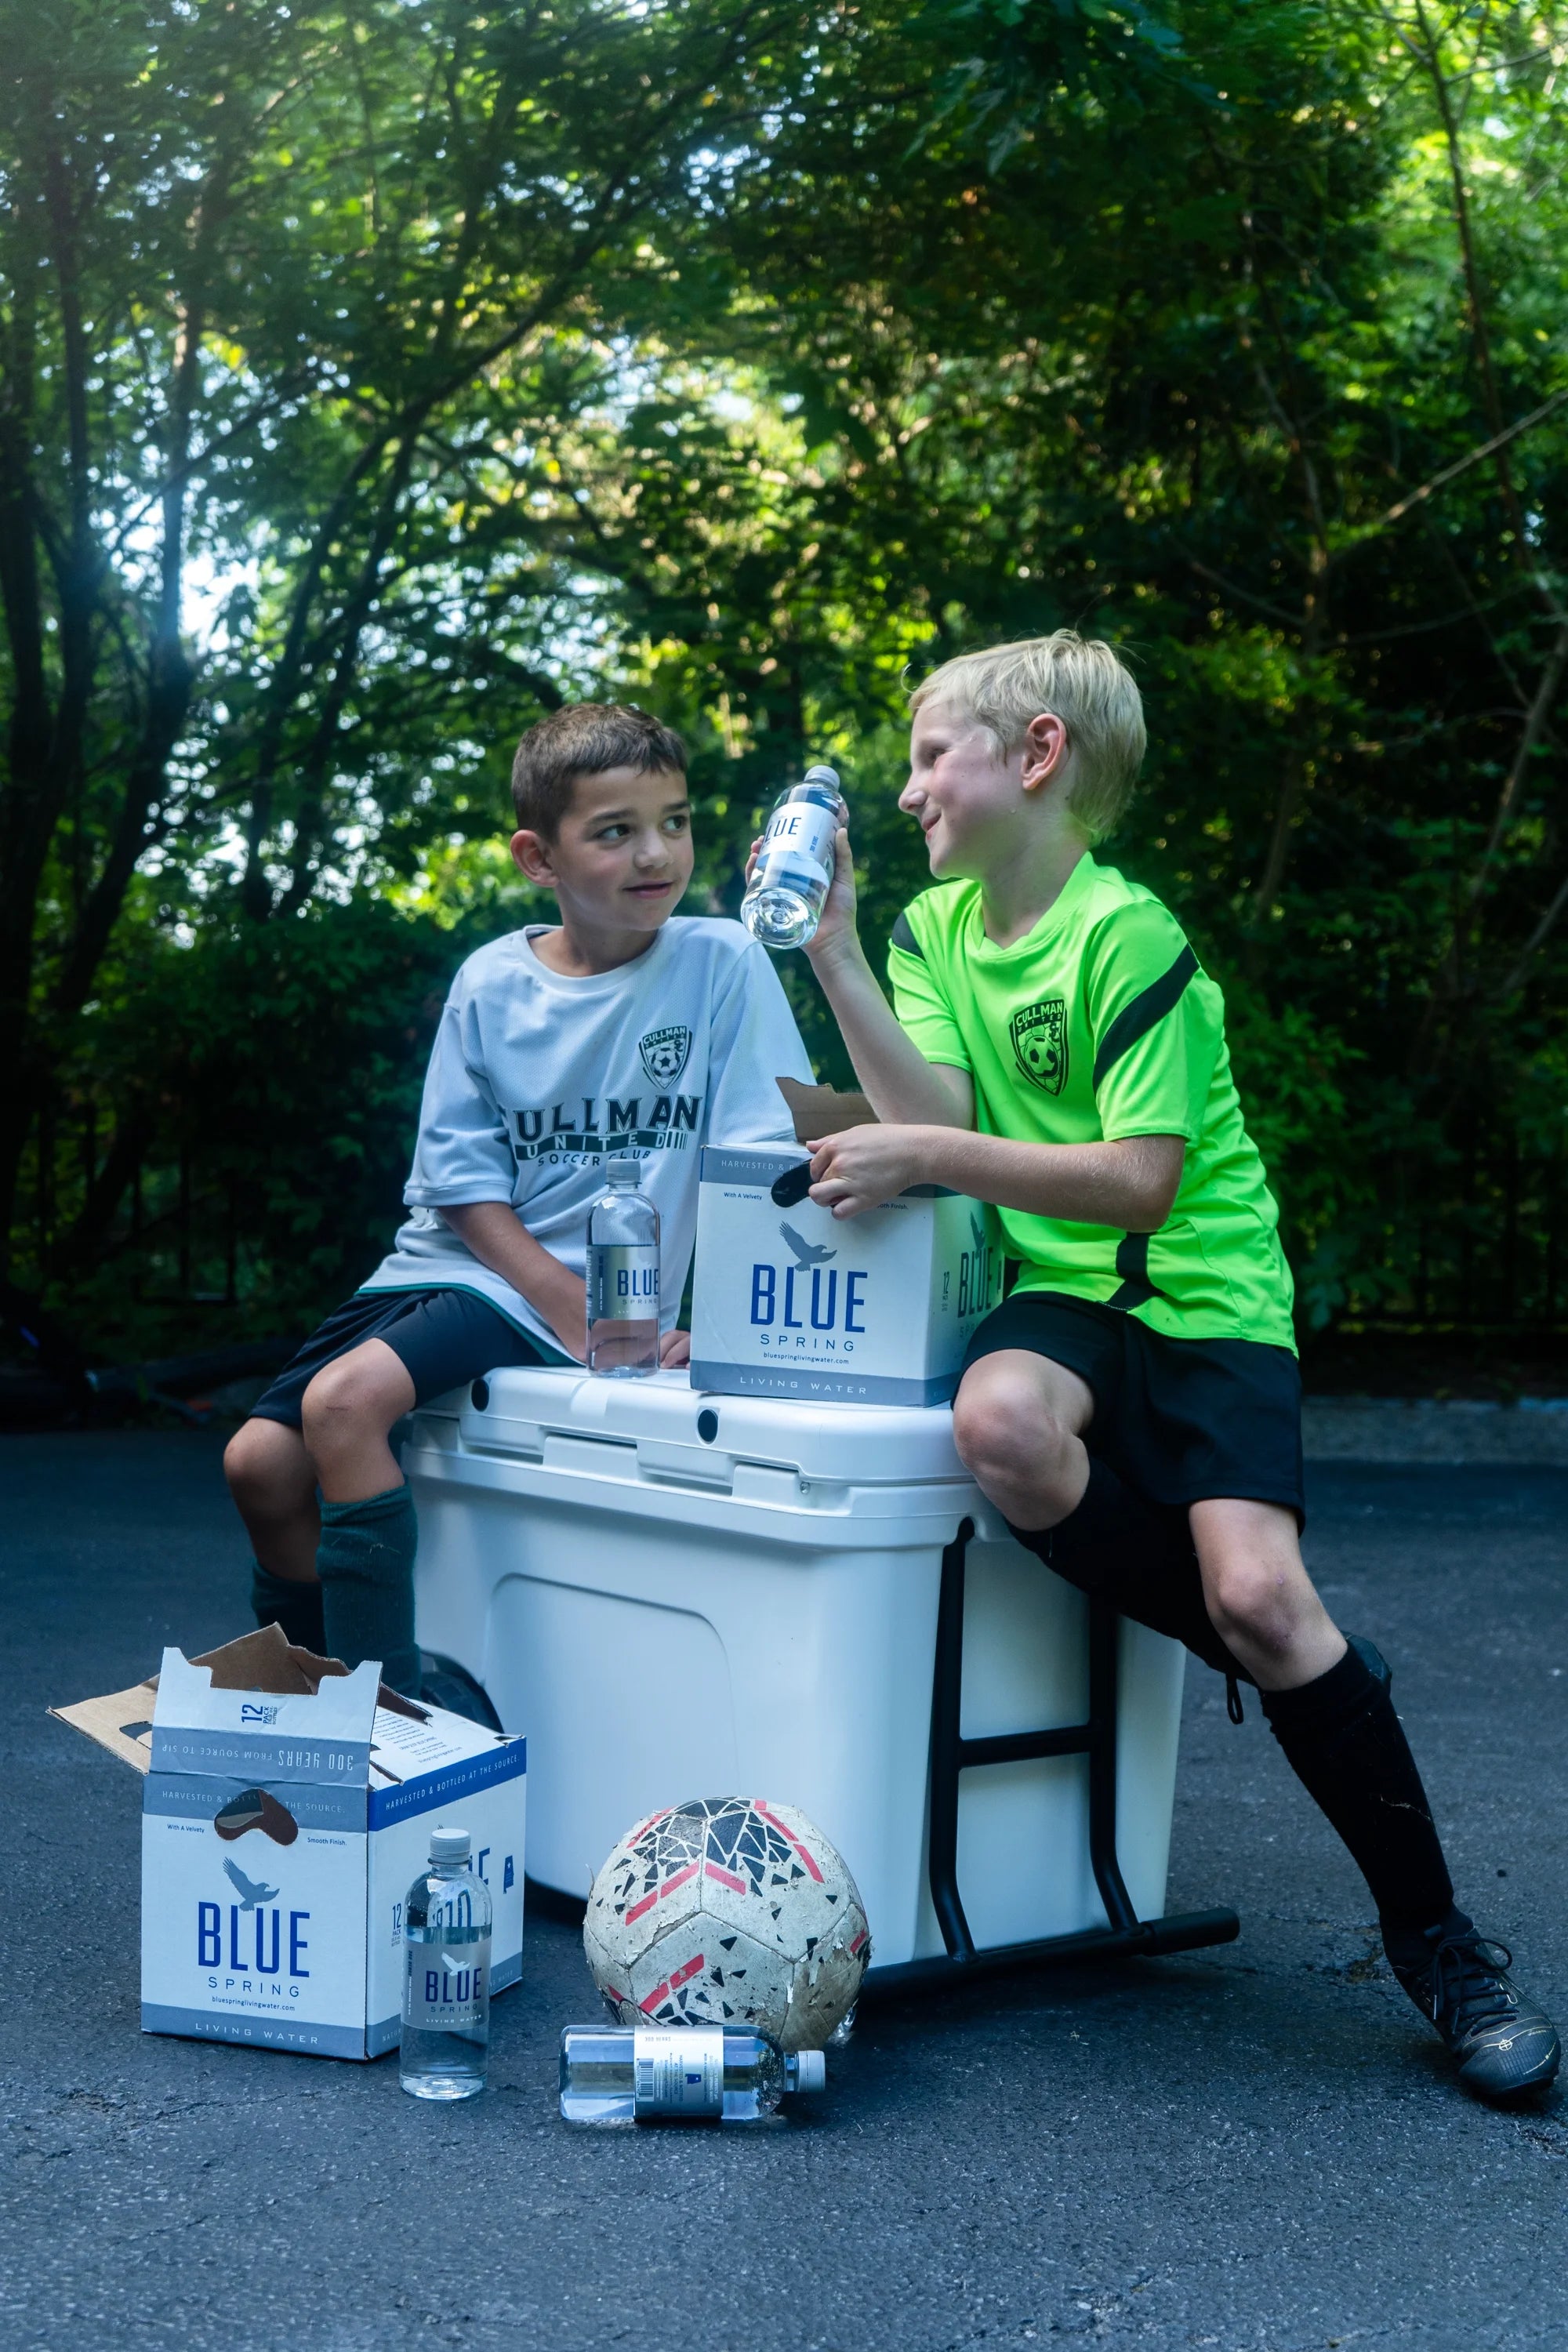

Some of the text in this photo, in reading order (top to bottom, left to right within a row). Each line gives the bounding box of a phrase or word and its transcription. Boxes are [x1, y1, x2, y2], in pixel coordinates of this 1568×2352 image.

[765, 817, 802, 843] LUE
[1016, 1002, 1063, 1027] CULLMAN
[1018, 1014, 1062, 1033] UNITED
[643, 1027, 686, 1044] CULLMAN
[512, 1094, 703, 1144] ULLMAN
[525, 1131, 666, 1159] UNITED
[538, 1153, 601, 1167] SOCCER
[721, 1160, 774, 1171] HARVESTED
[617, 1268, 659, 1296] BLUE
[943, 1271, 950, 1294] 12
[957, 1247, 993, 1319] BLUE
[750, 1264, 868, 1333] BLUE
[760, 1334, 855, 1352] SPRING
[763, 1352, 849, 1365] bluespringlivingwater.com
[740, 1376, 866, 1395] LIVING WATER
[241, 1704, 263, 1722] 12
[162, 1744, 354, 1771] 300 YEARS FROM SOURCE TO SIP
[386, 1754, 520, 1810] HARVESTED & BOTTLED AT THE SOURCE.
[162, 1791, 213, 1802] HARVESTED
[285, 1801, 302, 1810] THE
[306, 1802, 346, 1813] SOURCE.
[186, 1825, 205, 1834] Velvety
[329, 1838, 347, 1846] Finish.
[392, 1903, 401, 1929] 12
[198, 1901, 310, 1977] BLUE
[209, 1976, 299, 1998] SPRING
[425, 1967, 482, 2003] BLUE
[212, 1995, 296, 2011] bluespringlivingwater.com
[430, 2003, 477, 2013] SPRING
[195, 2023, 319, 2045] LIVING WATER
